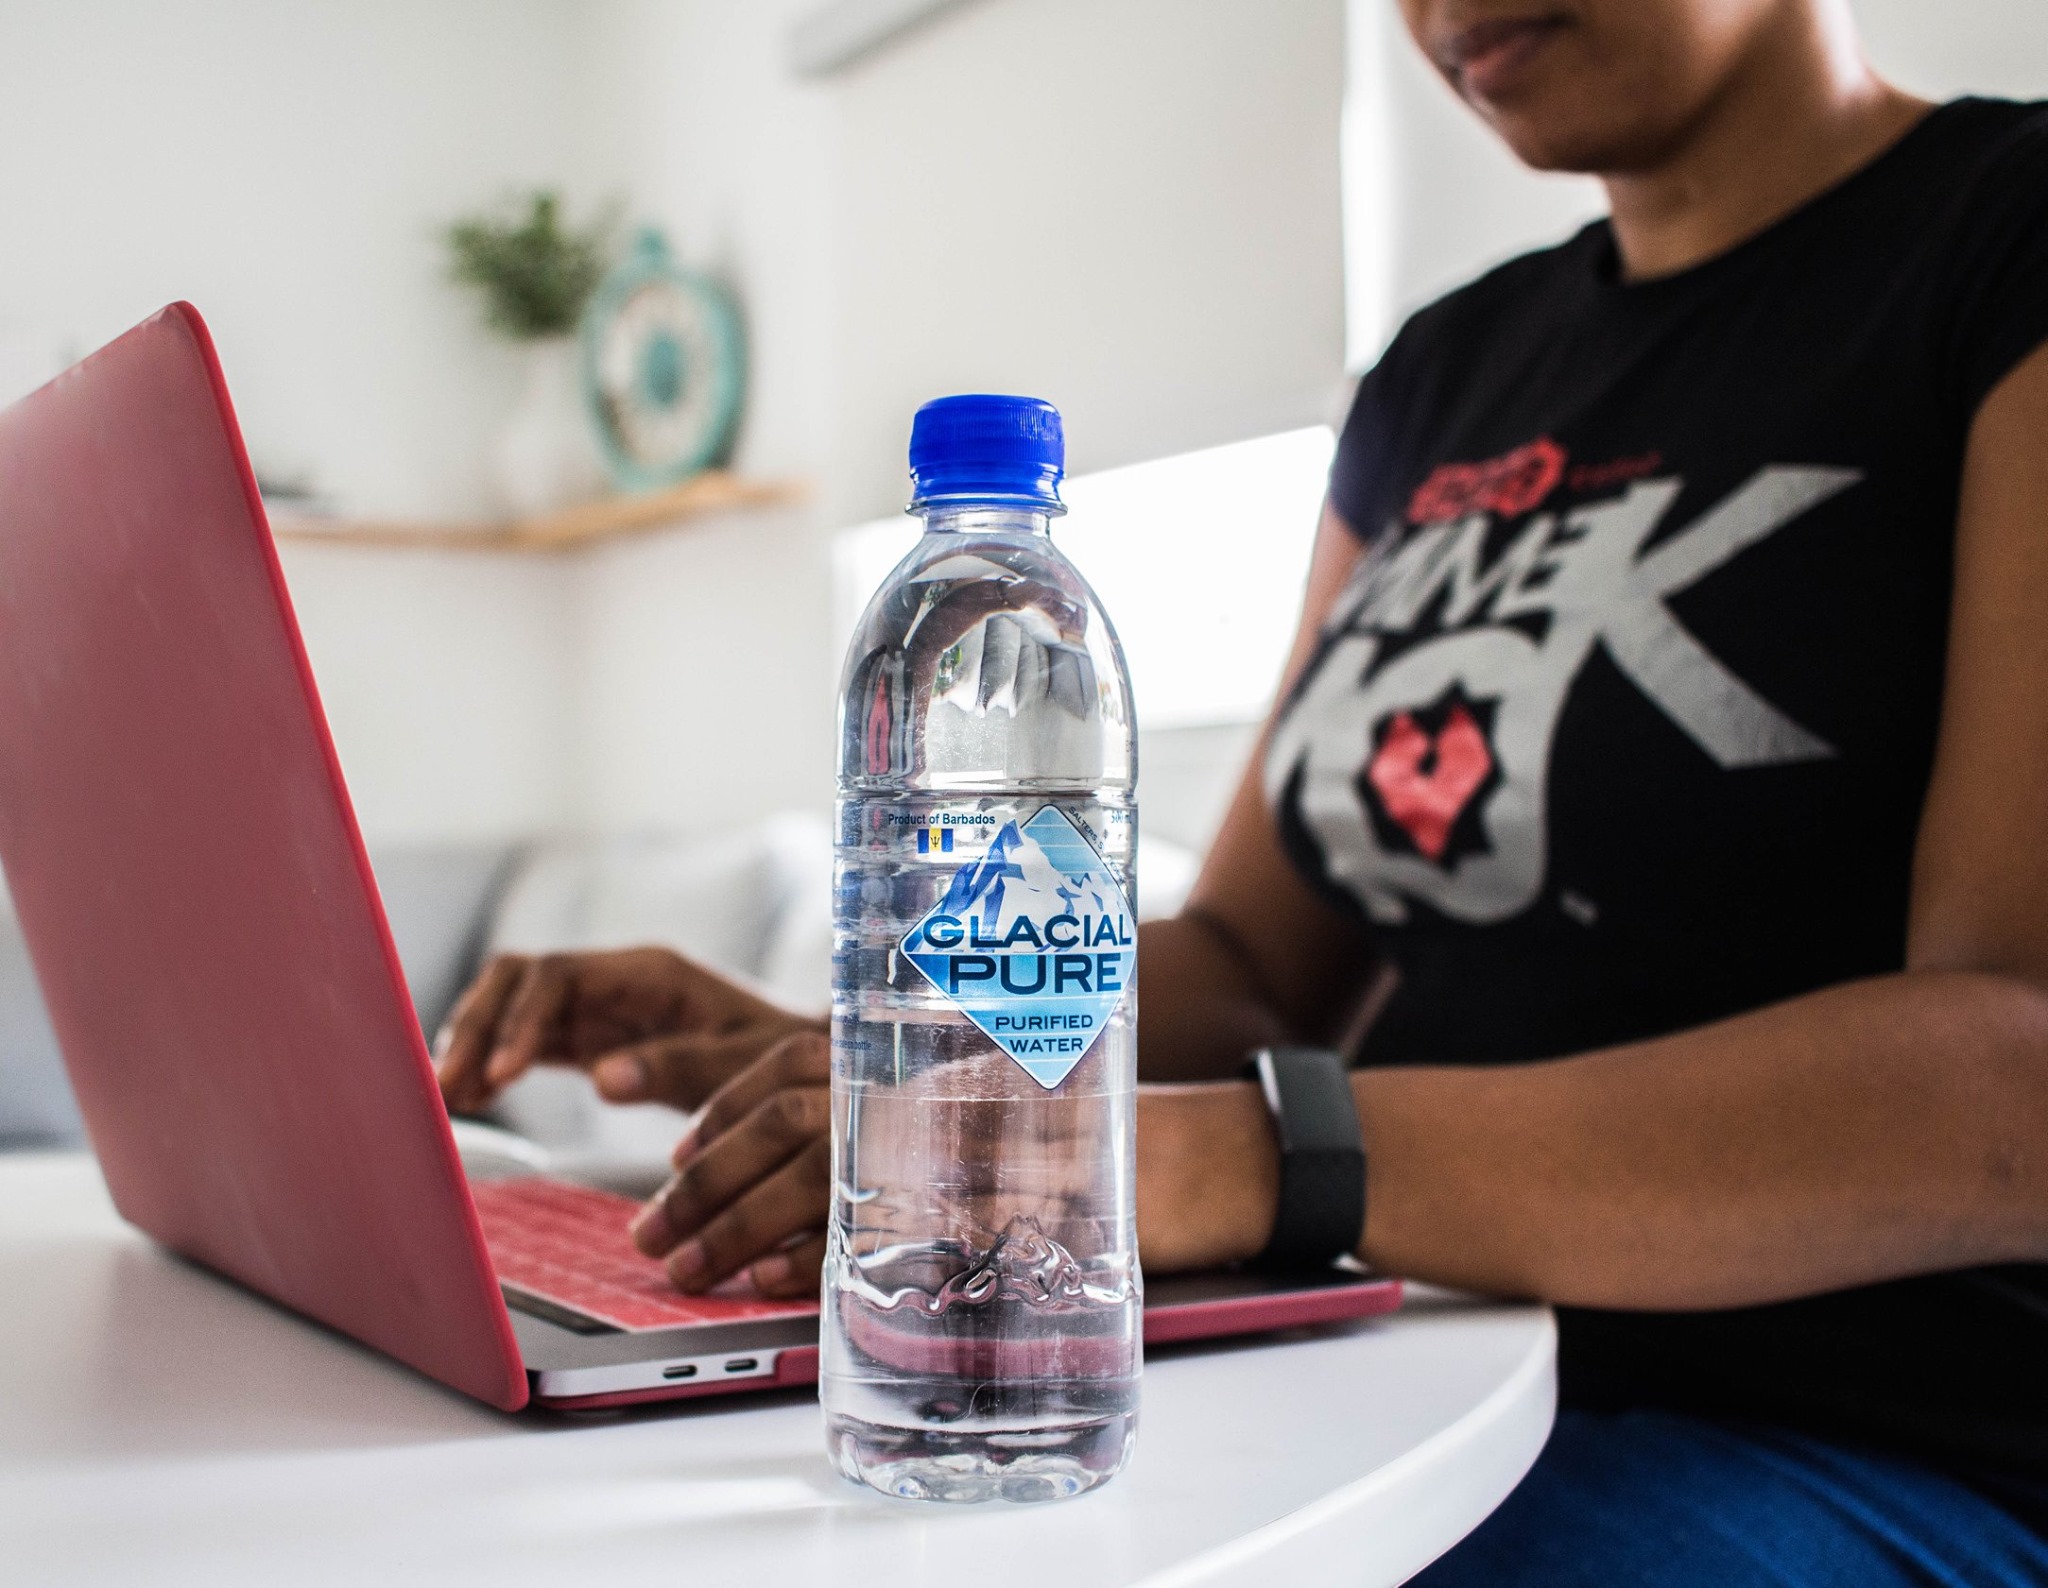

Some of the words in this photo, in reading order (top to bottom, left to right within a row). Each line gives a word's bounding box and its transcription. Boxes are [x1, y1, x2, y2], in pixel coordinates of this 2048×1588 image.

[888, 813, 926, 825] Product
[929, 813, 940, 825] of
[943, 813, 996, 825] Barbados
[922, 914, 1132, 949] GLACIAL
[949, 953, 1122, 995] PURE
[995, 1014, 1093, 1030] PURIFIED
[1009, 1037, 1083, 1053] WATER
